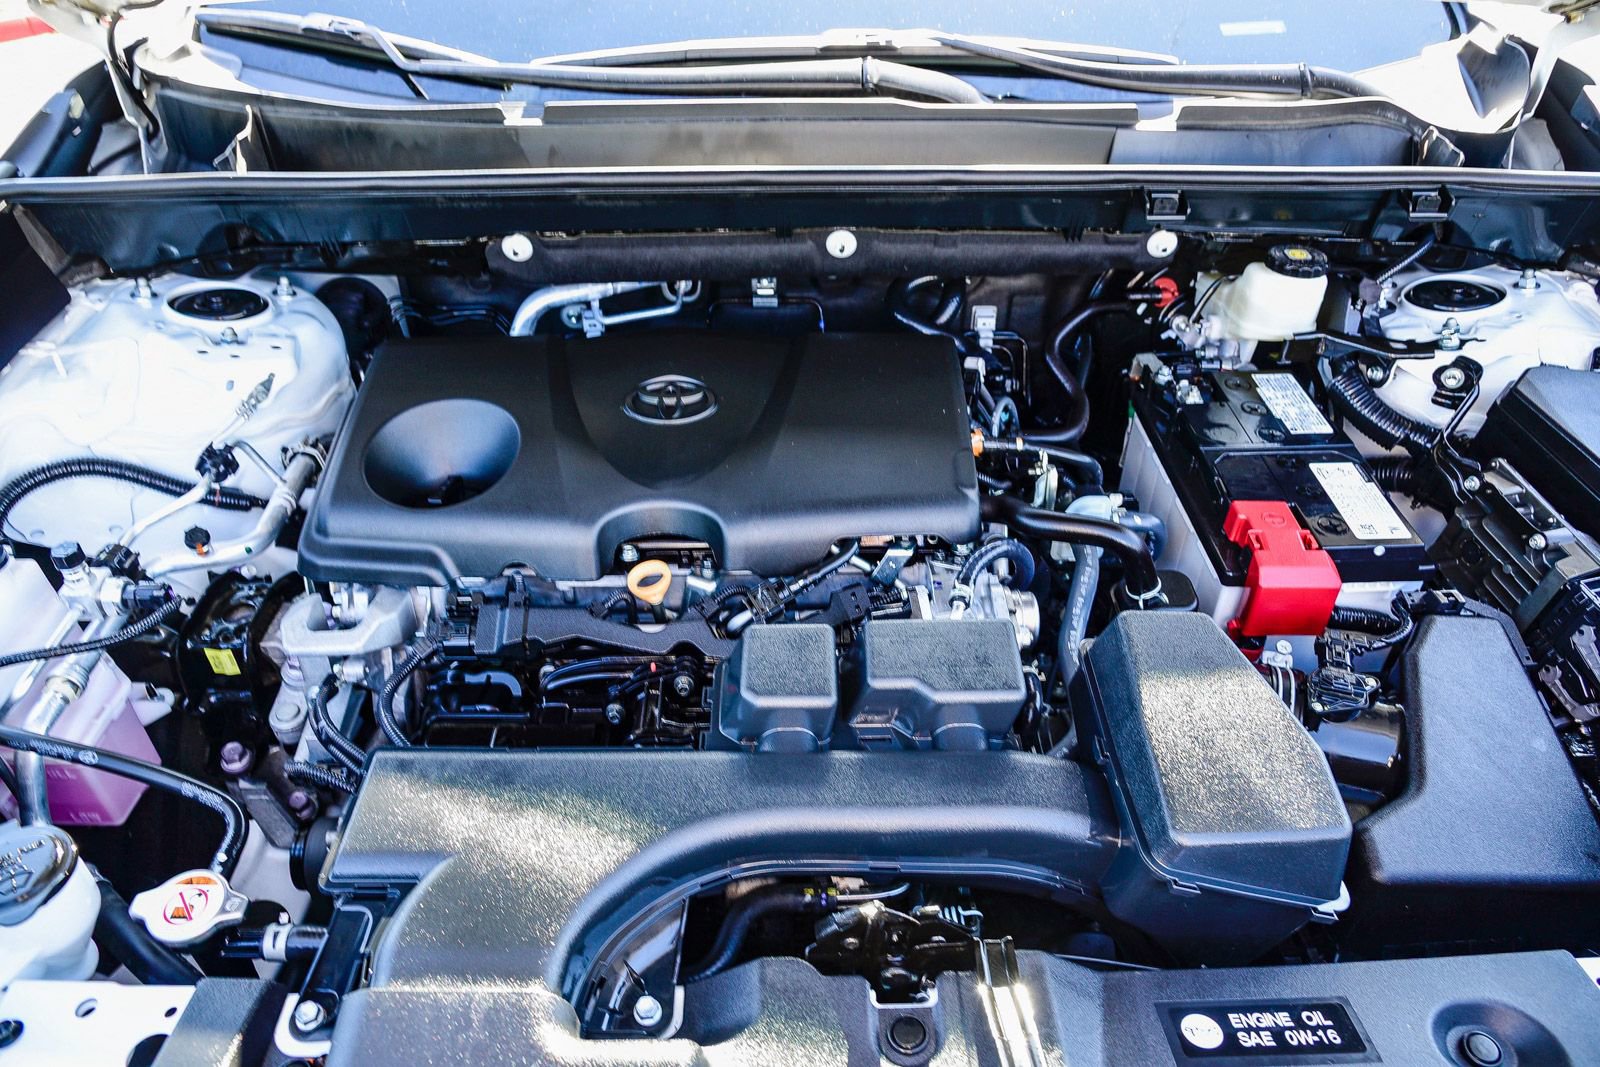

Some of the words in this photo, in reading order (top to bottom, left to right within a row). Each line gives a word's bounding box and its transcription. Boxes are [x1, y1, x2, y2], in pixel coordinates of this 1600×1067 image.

[1227, 1012, 1295, 1028] ENGINE
[1301, 1010, 1334, 1027] OIL
[1236, 1030, 1277, 1047] SAE
[1284, 1028, 1342, 1046] 0W-16
